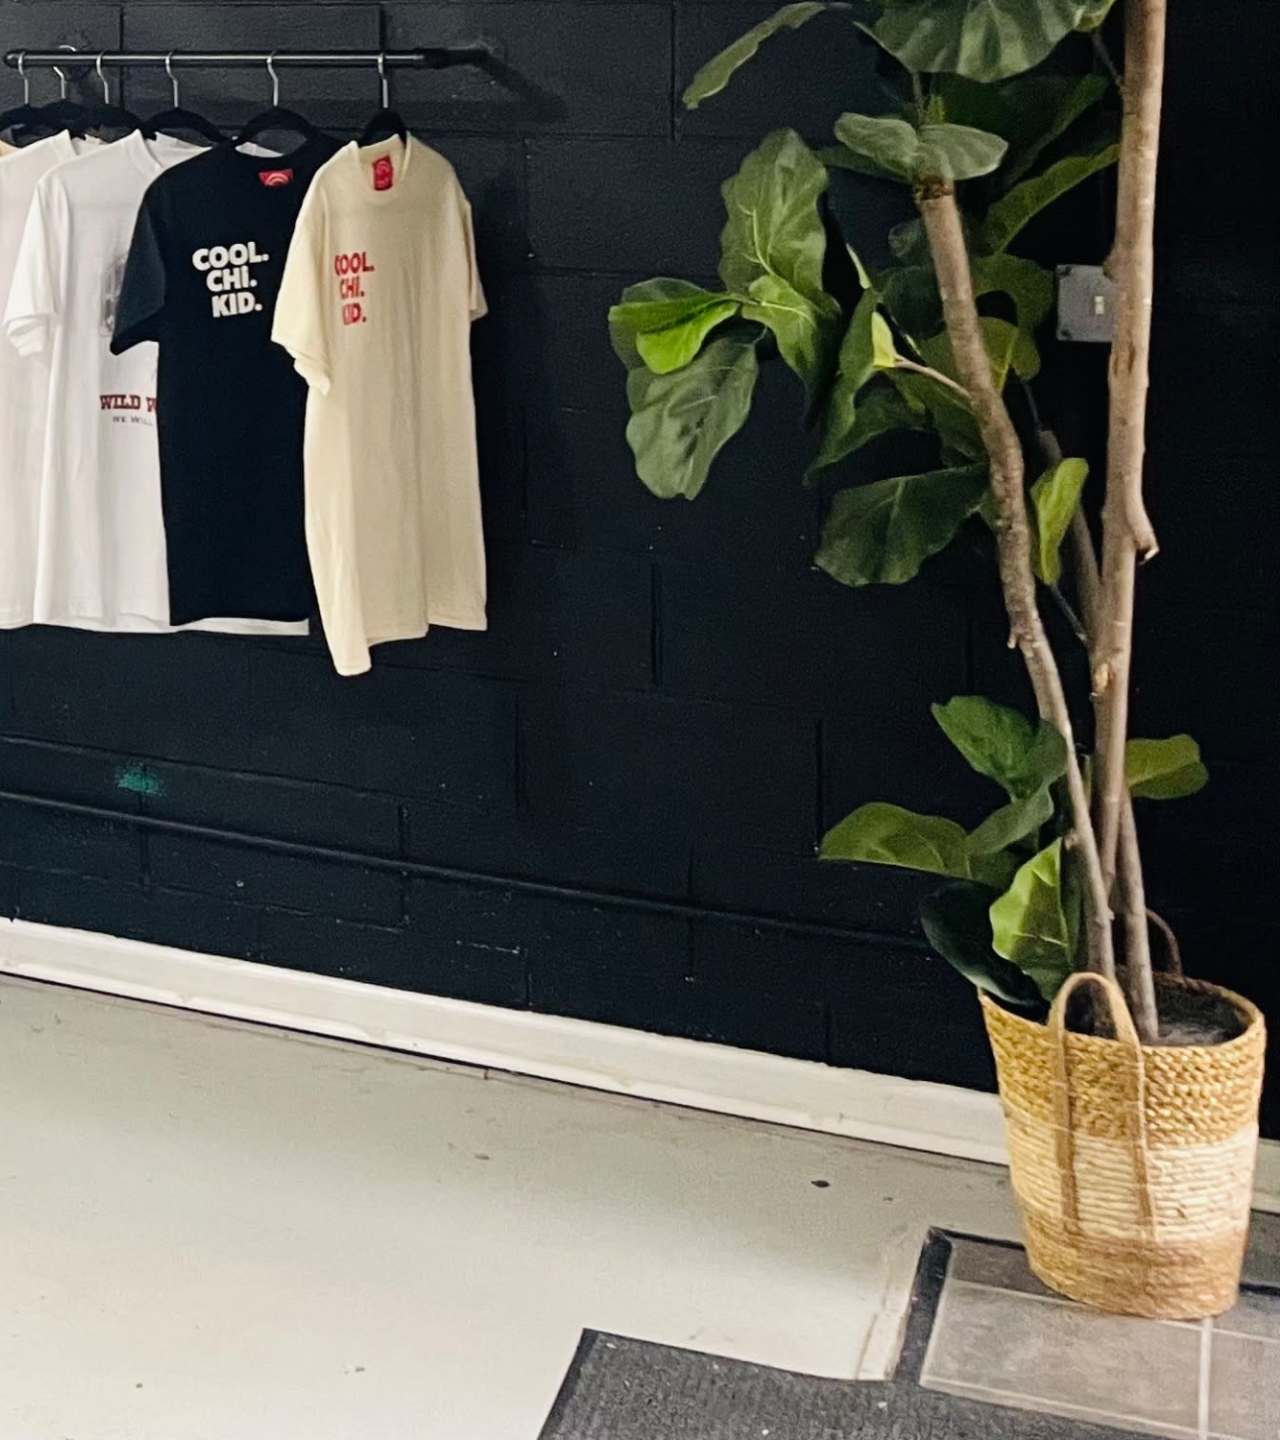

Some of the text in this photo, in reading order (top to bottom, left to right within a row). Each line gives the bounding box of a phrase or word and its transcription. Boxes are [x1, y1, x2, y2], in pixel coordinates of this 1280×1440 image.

[192, 241, 269, 271] COOL.
[211, 291, 263, 318] KID.
[99, 393, 141, 410] WILD
